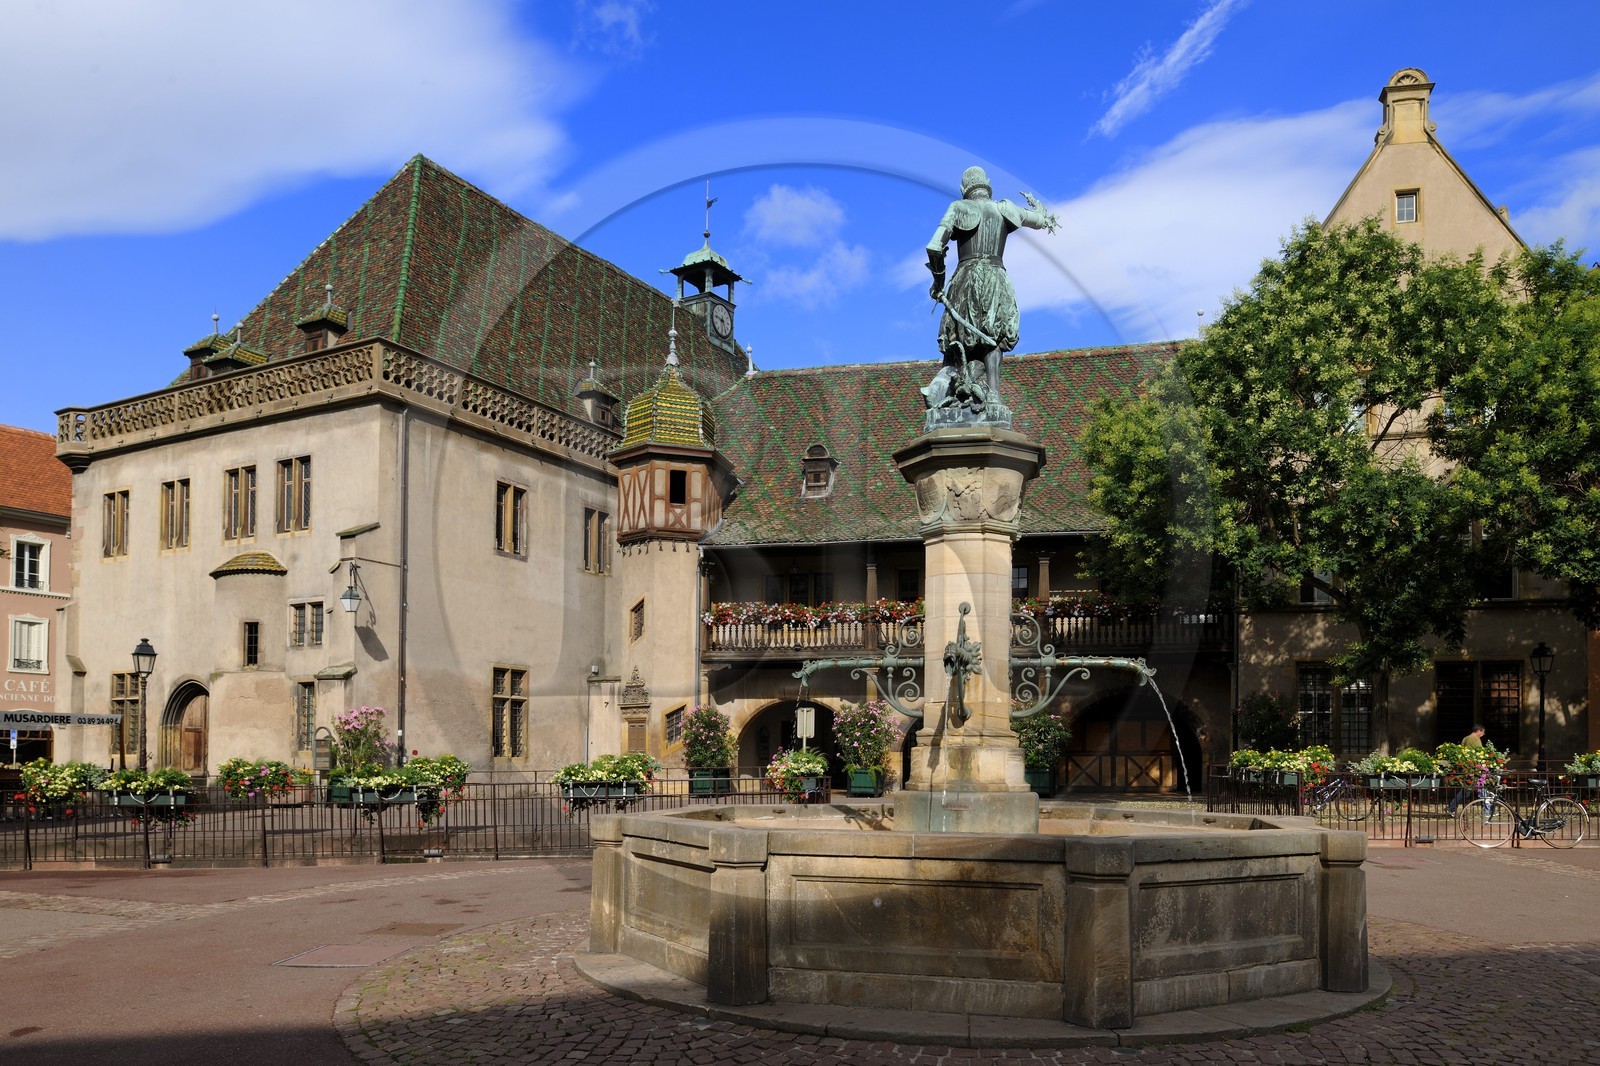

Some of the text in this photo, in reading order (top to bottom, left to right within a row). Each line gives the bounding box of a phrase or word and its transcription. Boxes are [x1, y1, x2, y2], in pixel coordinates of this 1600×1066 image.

[4, 678, 50, 693] CAFÉ
[3, 713, 71, 724] MUSARDIERE
[77, 717, 86, 725] 03
[87, 717, 96, 725] 89
[96, 717, 105, 725] 24
[105, 717, 114, 725] 49
